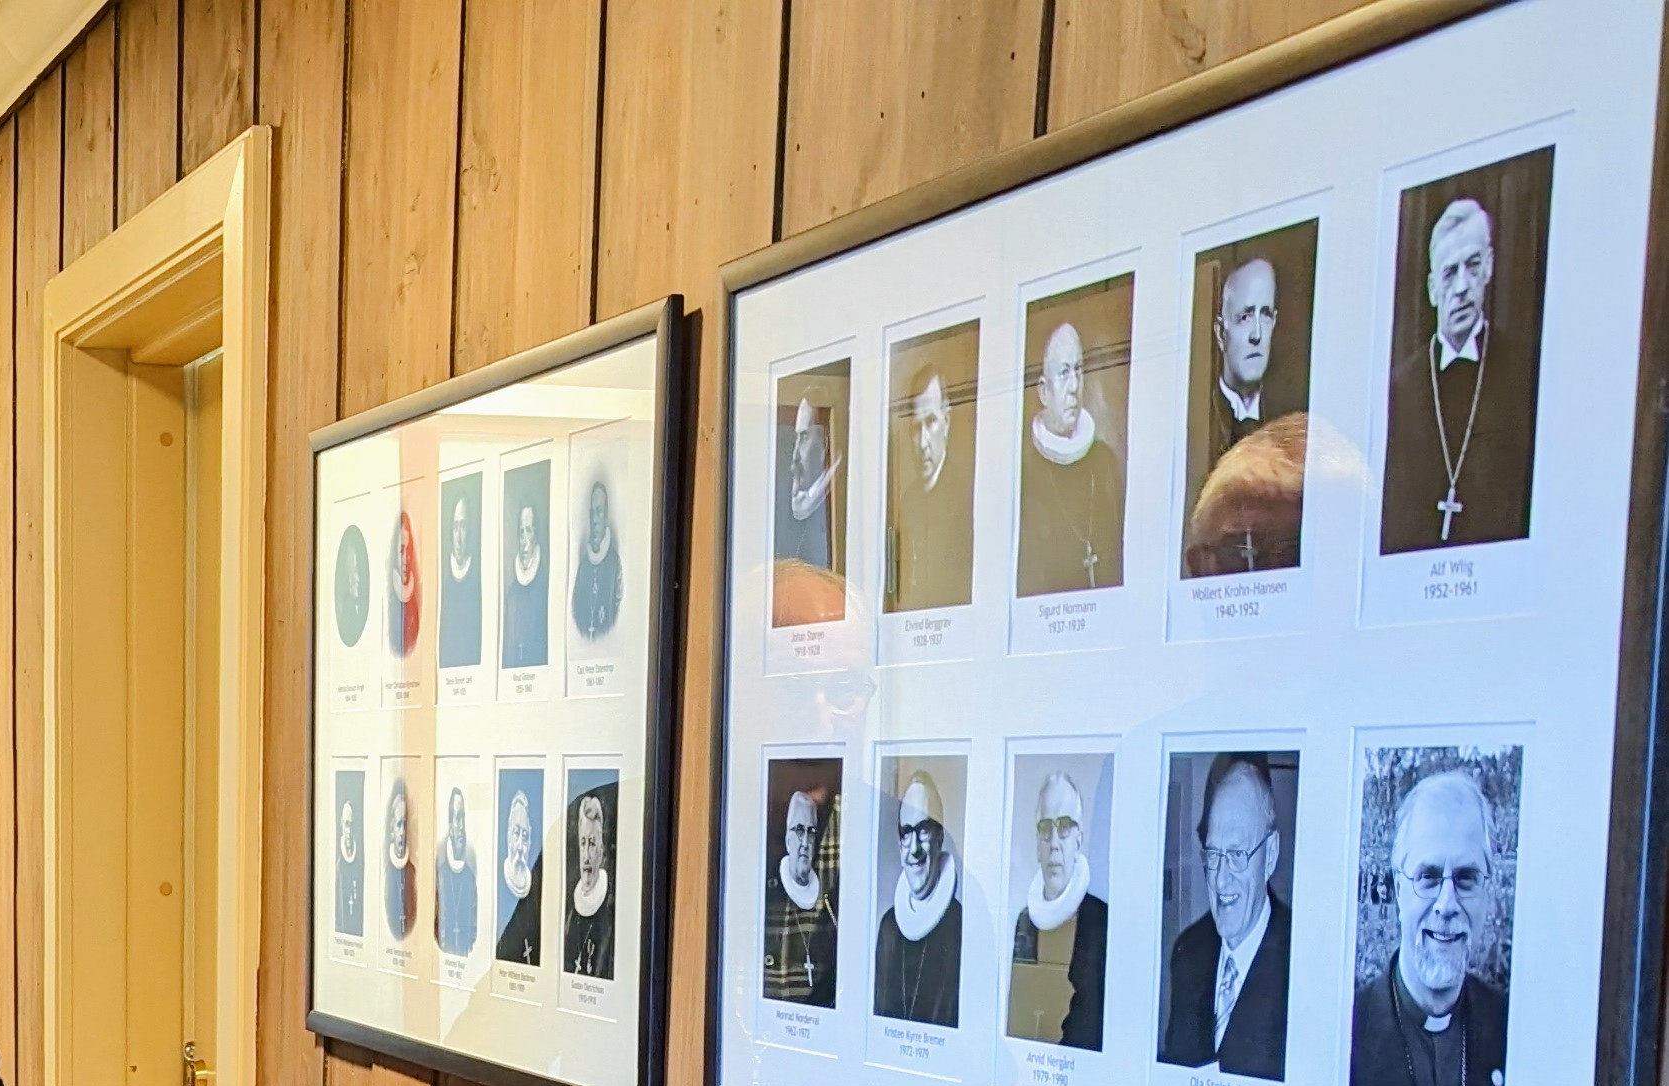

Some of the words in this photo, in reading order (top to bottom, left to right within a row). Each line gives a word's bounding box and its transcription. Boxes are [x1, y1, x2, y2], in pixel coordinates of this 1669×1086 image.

[1430, 560, 1446, 577] Alf
[1192, 586, 1222, 601] Wollert
[1224, 582, 1287, 598] Krohn-Hansen
[1423, 580, 1478, 599] 1952-1961
[1038, 604, 1061, 620] Sigurd
[1062, 602, 1097, 615] Normann
[1215, 602, 1260, 618] 1940-1952
[1048, 618, 1085, 633] 1937-1939
[1026, 1052, 1045, 1065] Arvid
[1032, 1069, 1069, 1086] 1979-1990
